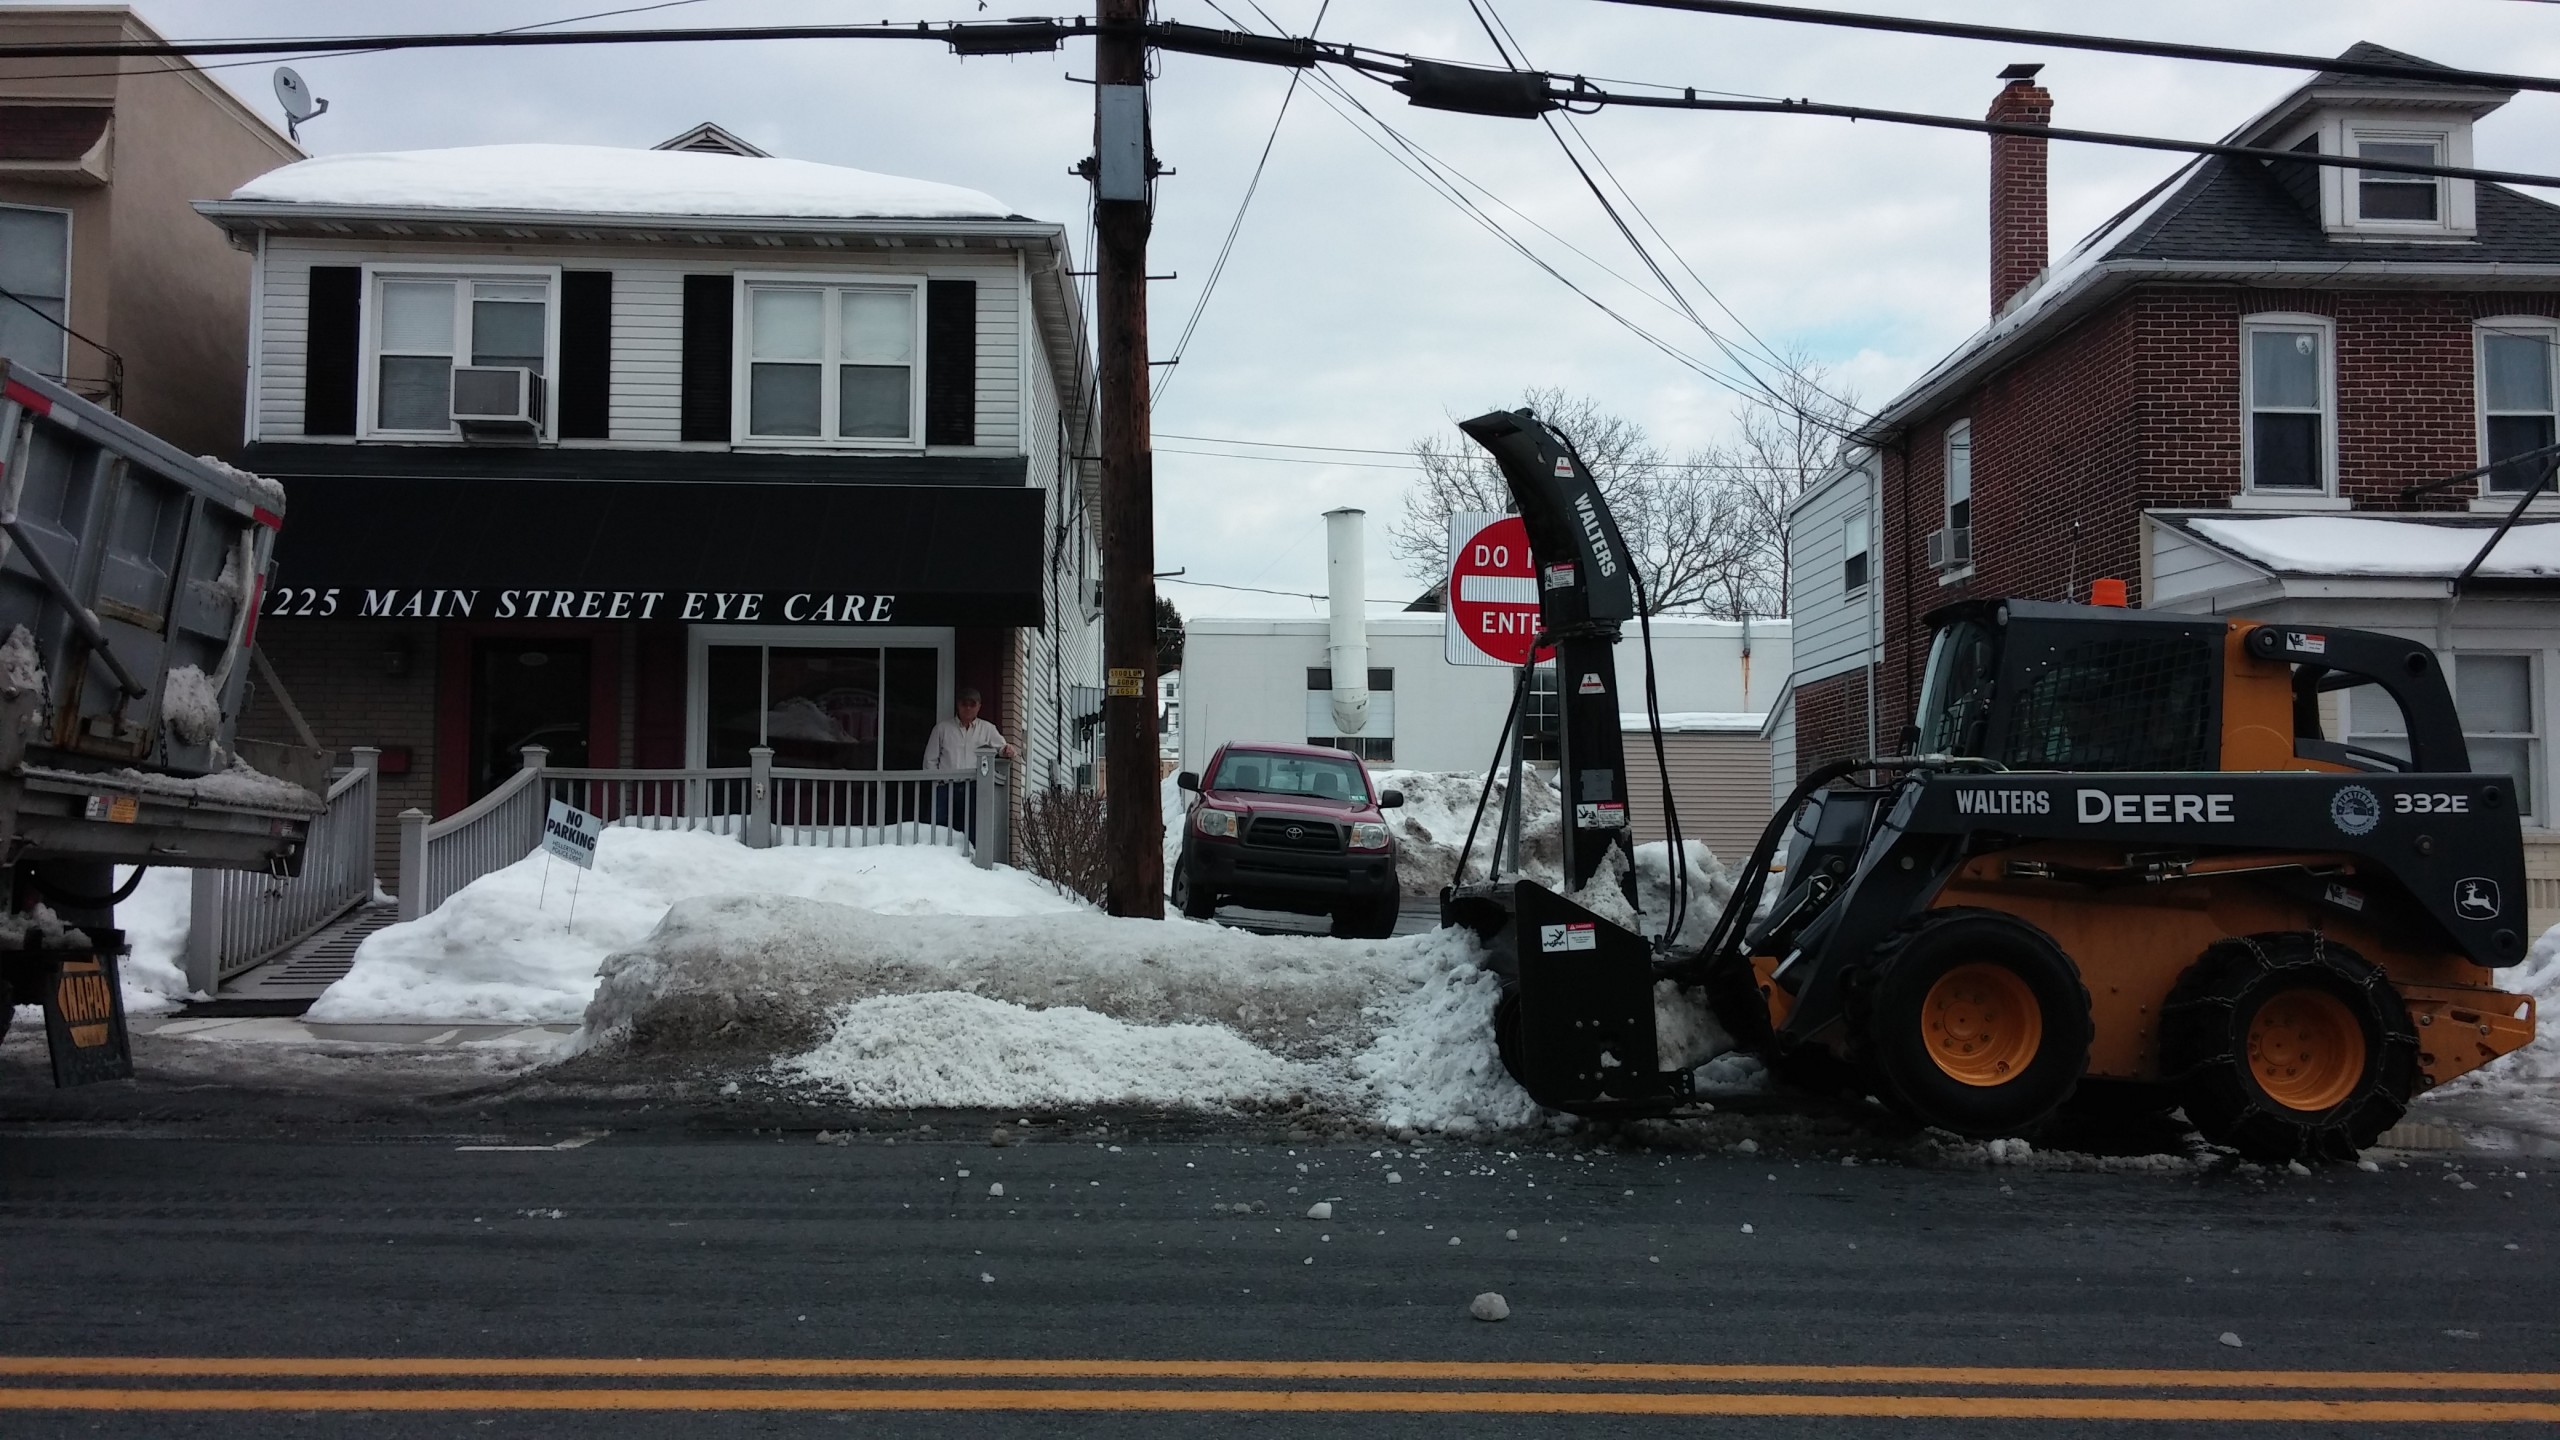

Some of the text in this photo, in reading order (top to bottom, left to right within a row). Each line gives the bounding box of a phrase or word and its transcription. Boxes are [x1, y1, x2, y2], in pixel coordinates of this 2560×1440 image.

[1574, 492, 1617, 577] WALTERS
[1474, 544, 1509, 568] DO
[357, 588, 481, 618] MAIN
[493, 589, 665, 619] STREET
[678, 592, 764, 621] EYE
[783, 593, 896, 622] CARE
[1482, 611, 1543, 635] ENTE
[1955, 789, 2050, 815] WALTERS
[2076, 788, 2236, 824] DEERE
[2393, 793, 2470, 813] 332E
[566, 809, 583, 828] NO
[546, 818, 596, 851] PARKING
[551, 840, 585, 858] HELLERTOWN
[66, 975, 106, 1021] NAPA
